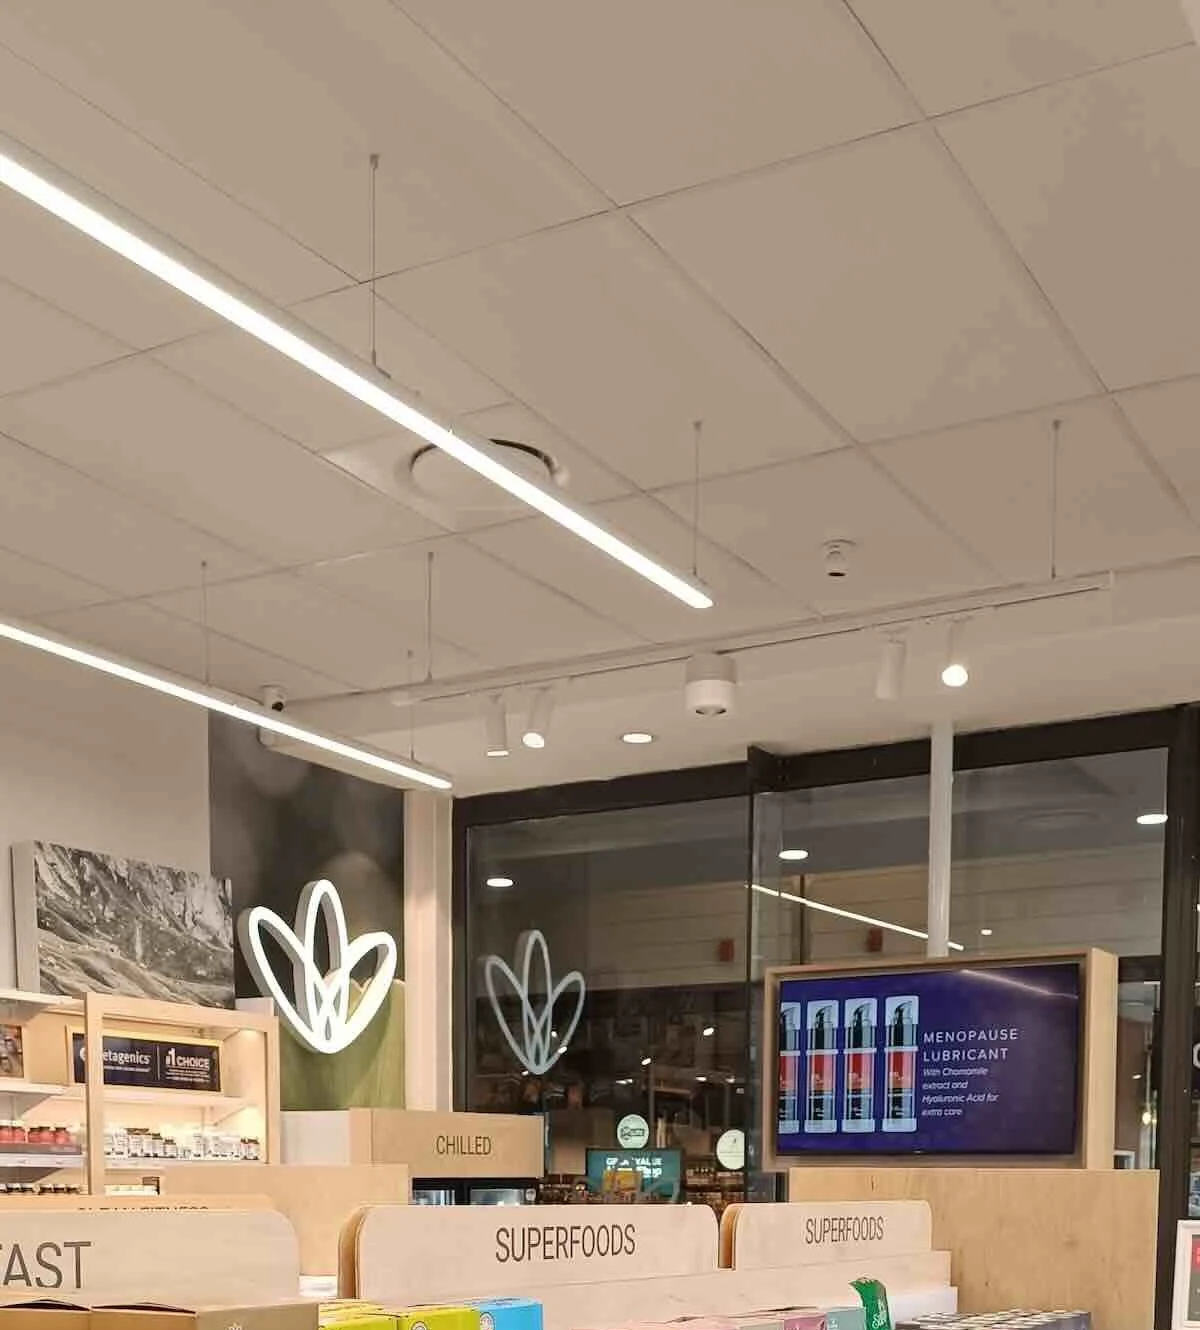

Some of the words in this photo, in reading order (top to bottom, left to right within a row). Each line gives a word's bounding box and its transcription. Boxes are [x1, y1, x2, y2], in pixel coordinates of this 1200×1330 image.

[923, 1029, 1018, 1043] MENOPAUSE
[103, 1048, 150, 1065] etagenics
[923, 1048, 1009, 1061] LUBRICANT
[177, 1055, 210, 1069] CHOICE
[942, 1067, 988, 1076] Chamomile
[922, 1082, 950, 1090] extract
[951, 1081, 968, 1089] and
[922, 1094, 965, 1104] Hyaluronic
[966, 1093, 986, 1102] Acid
[987, 1093, 999, 1102] for
[922, 1109, 943, 1117] extra
[435, 1134, 492, 1156] CHILLED
[805, 1215, 884, 1245] SUPERFOODS
[495, 1223, 636, 1263] SUPERFOODS
[0, 1240, 92, 1289] AST
